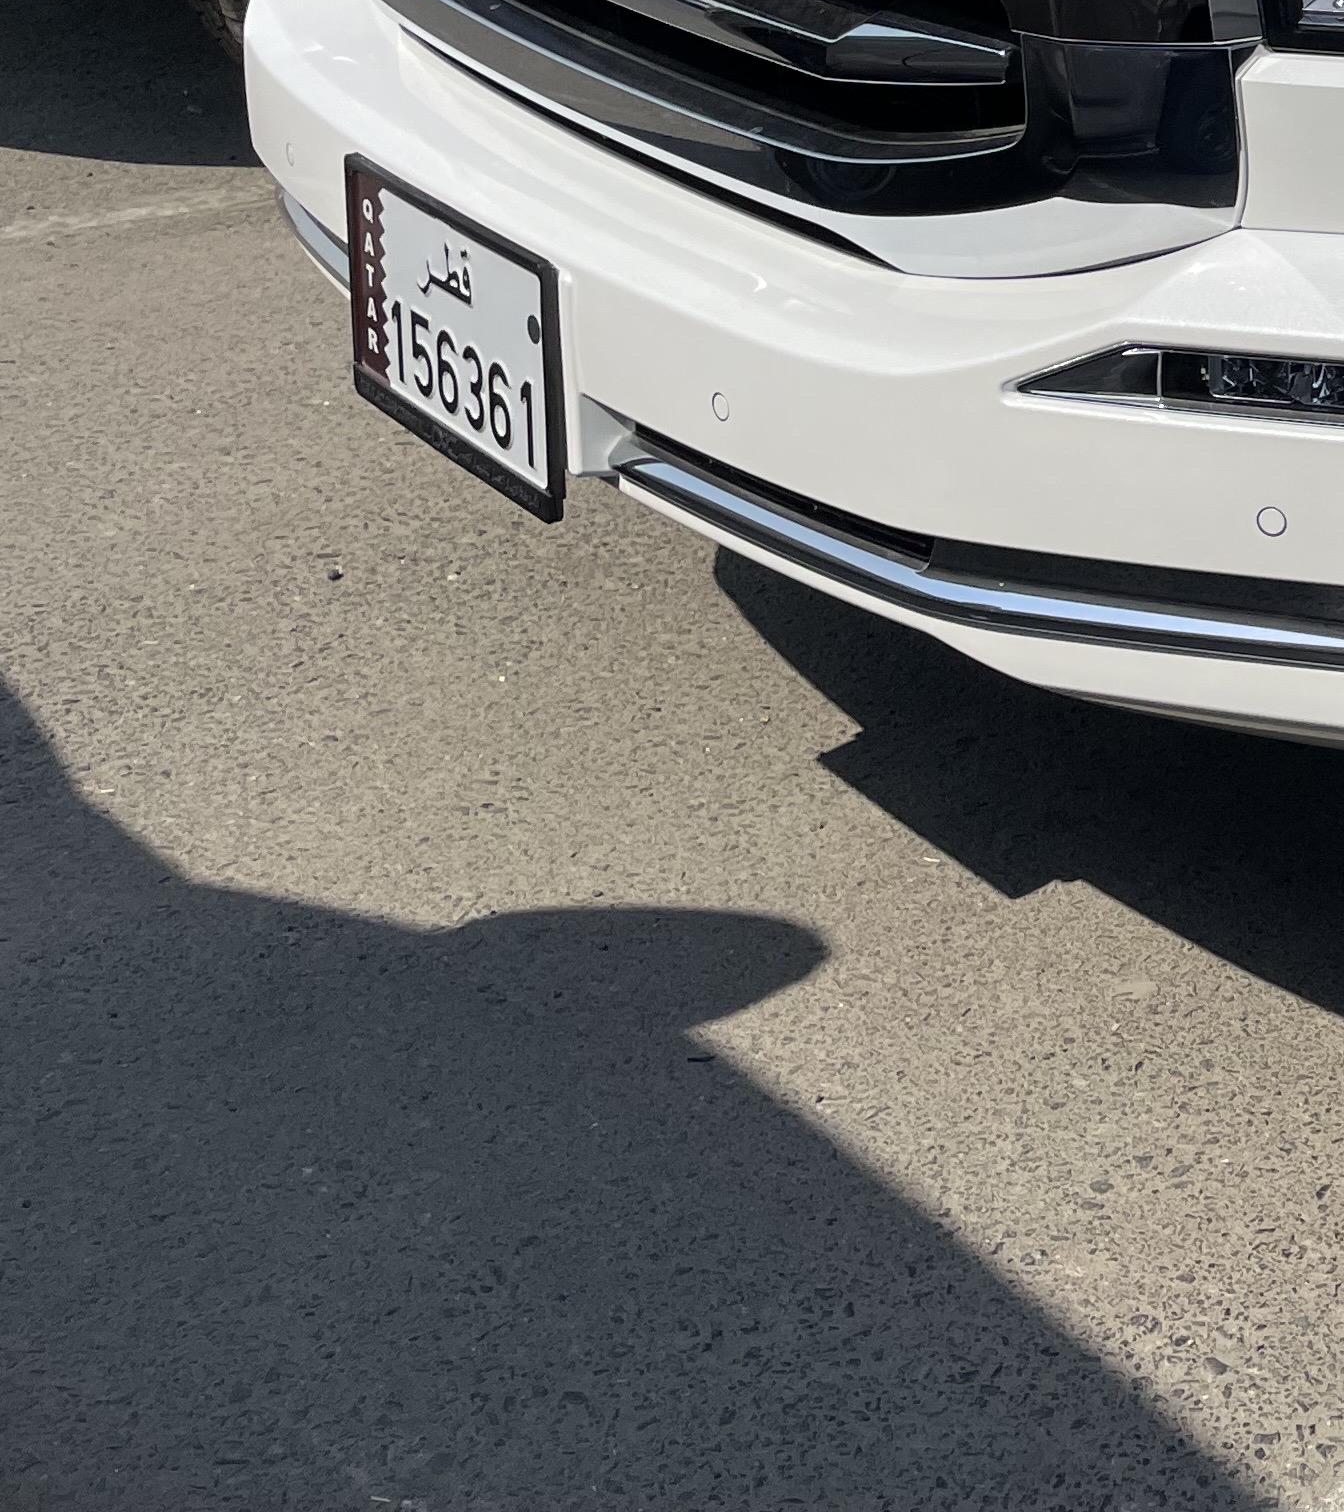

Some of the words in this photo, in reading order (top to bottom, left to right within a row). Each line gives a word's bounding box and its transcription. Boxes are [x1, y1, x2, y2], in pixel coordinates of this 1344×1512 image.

[362, 197, 380, 354] QATAR
[416, 242, 473, 306] قطر
[391, 300, 536, 469] 156361
